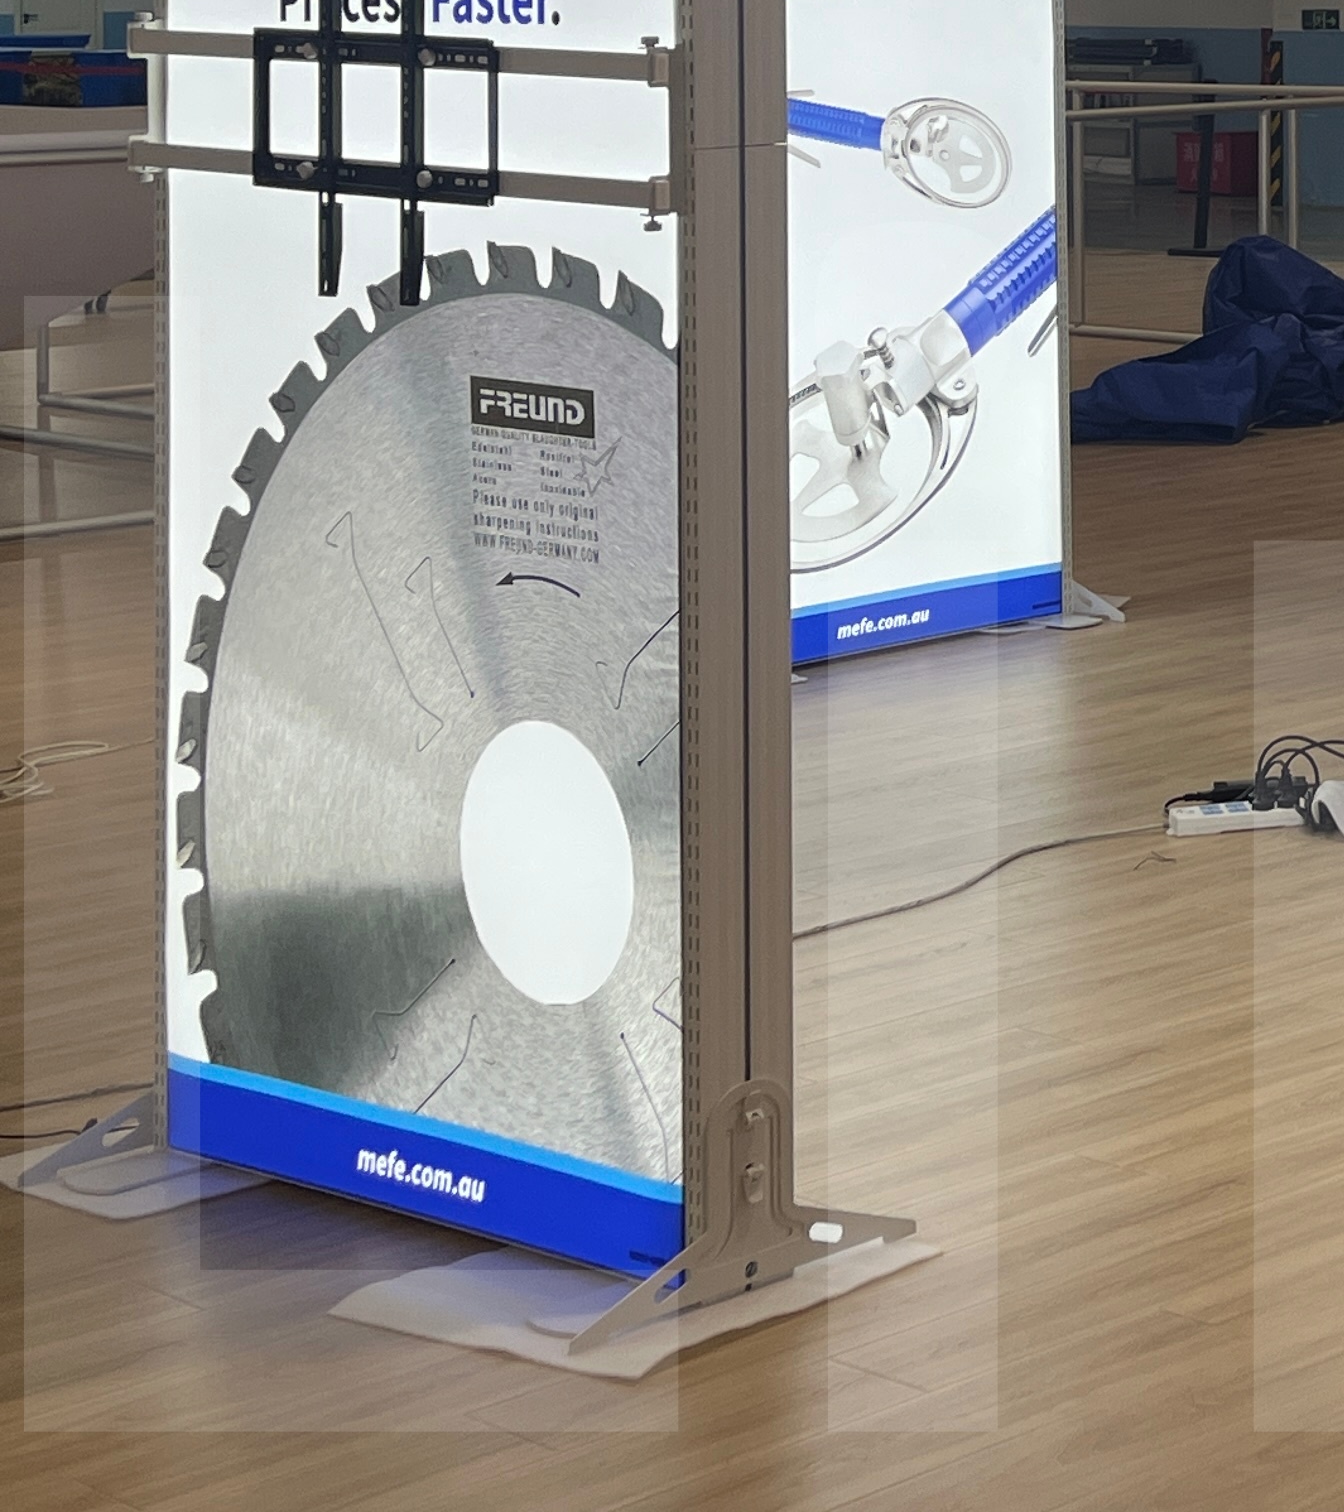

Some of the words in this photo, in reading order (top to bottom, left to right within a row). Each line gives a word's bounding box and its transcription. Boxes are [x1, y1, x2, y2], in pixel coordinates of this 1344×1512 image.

[479, 388, 585, 426] FREUND
[473, 489, 507, 508] Please
[512, 498, 529, 510] use
[534, 499, 555, 518] only
[559, 502, 598, 522] original
[474, 512, 531, 536] sharpening
[837, 609, 929, 639] mefe.com.au
[357, 1147, 485, 1203] mefe.com.au
